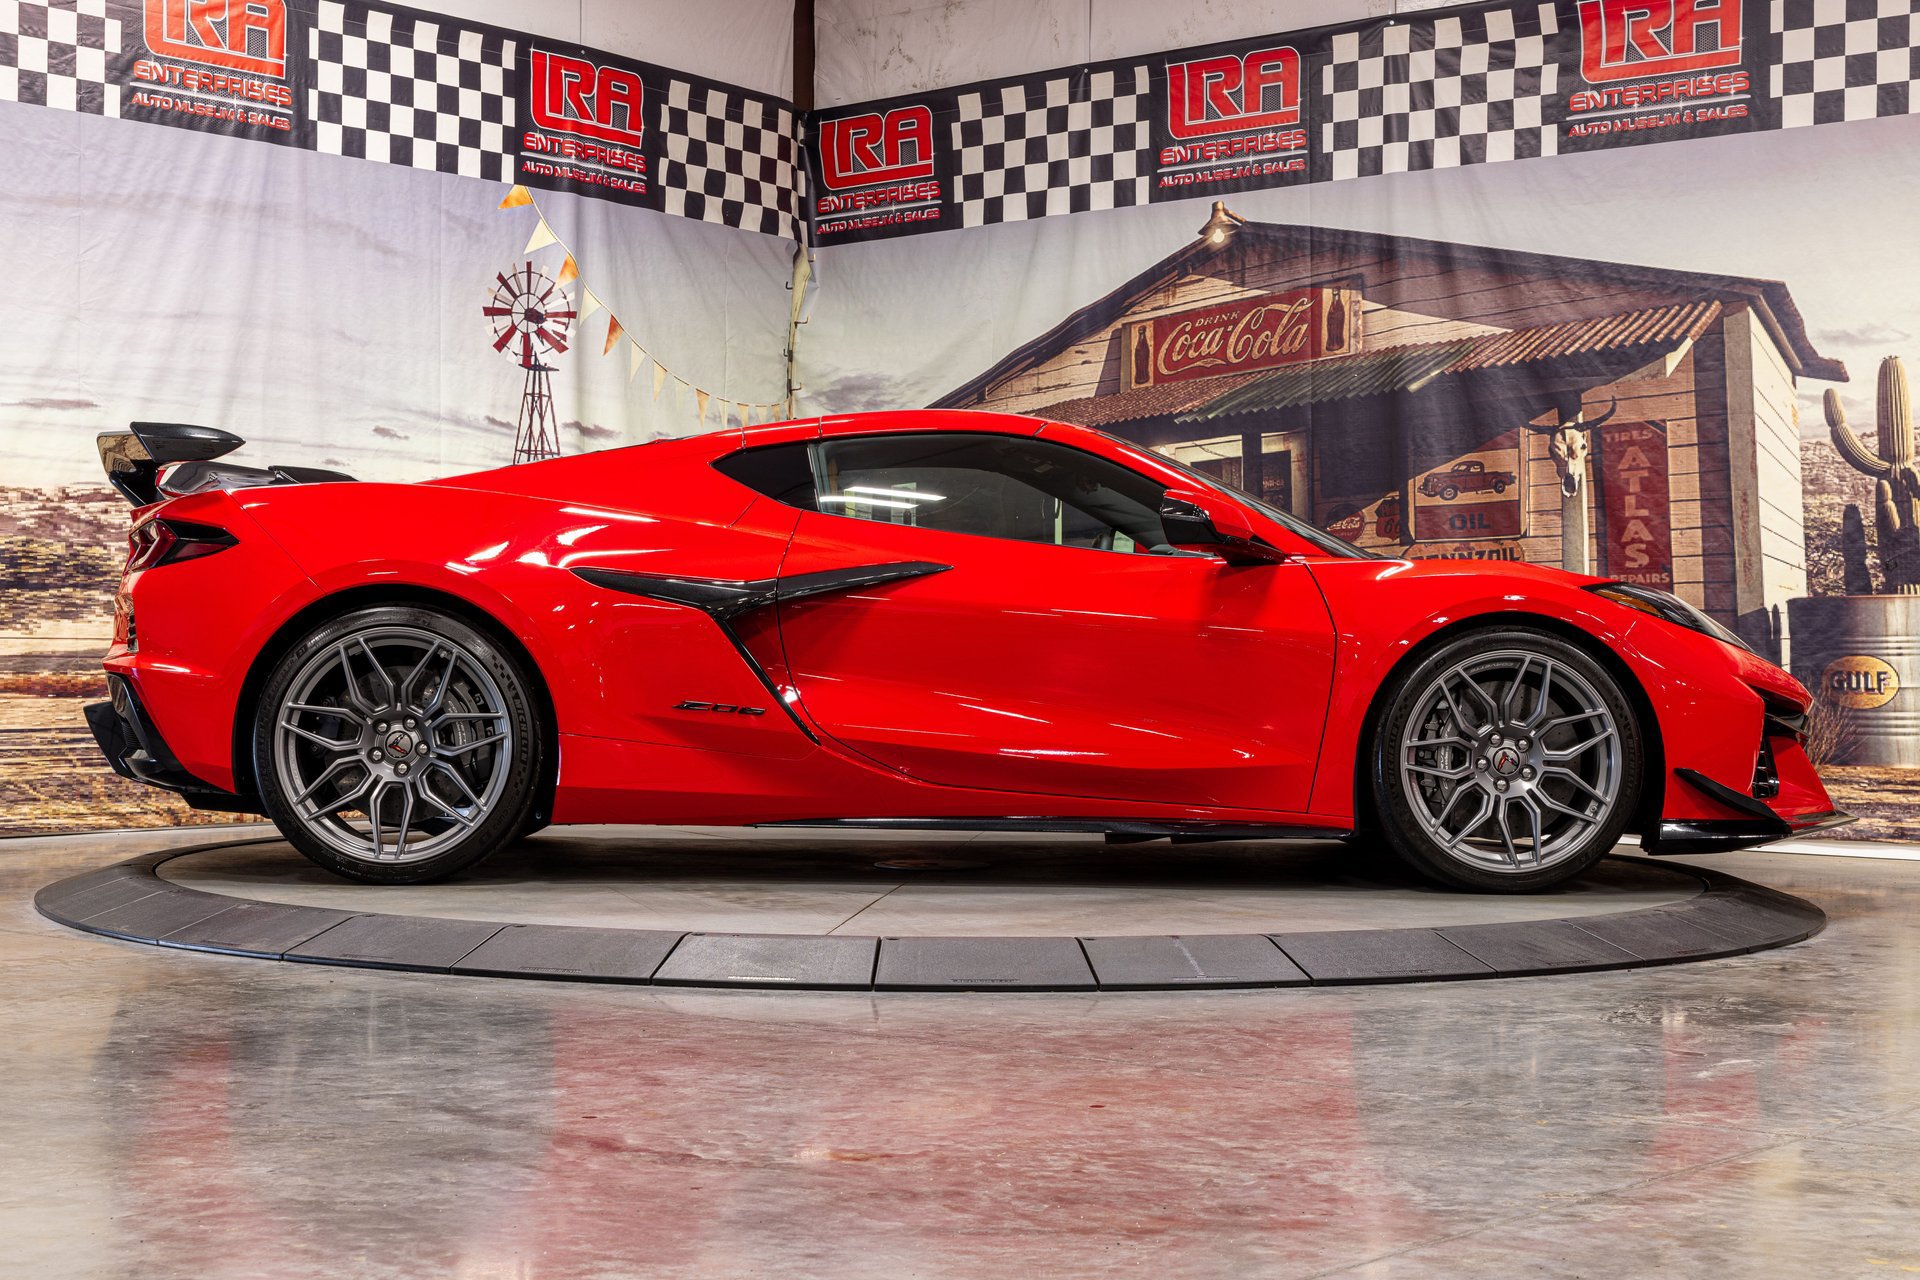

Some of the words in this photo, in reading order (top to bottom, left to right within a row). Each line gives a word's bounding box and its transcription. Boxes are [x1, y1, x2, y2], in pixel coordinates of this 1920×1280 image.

[133, 60, 293, 106] ENTERPRISES
[1569, 71, 1750, 112] ENTERPRISES
[130, 92, 172, 110] AUTO
[174, 99, 235, 121] MUSEUM
[237, 109, 248, 123] &
[248, 113, 291, 131] SALES
[1568, 119, 1612, 138] AUTO
[1613, 112, 1681, 132] MUSEUM
[1682, 110, 1694, 123] &
[1696, 104, 1749, 122] SALES
[523, 132, 647, 173] ENTERPRISES
[1159, 129, 1307, 165] ENTERPRISES
[522, 160, 553, 176] AUTO
[554, 166, 603, 184] MUSEUM
[603, 174, 610, 187] &
[611, 177, 647, 194] SALES
[1158, 171, 1194, 188] AUTO
[1194, 165, 1252, 183] MUSEUM
[1252, 163, 1262, 176] &
[1263, 159, 1306, 175] SALES
[817, 181, 940, 213] ENTERPRISES
[817, 221, 847, 234] AUTO
[848, 214, 895, 230] MUSEUM
[895, 213, 903, 223] &
[904, 208, 940, 223] SALES
[1195, 310, 1241, 327] DRINK
[1156, 297, 1316, 376] Coca-Cola
[1603, 429, 1653, 442] TIRES
[1450, 512, 1491, 530] OIL
[1617, 446, 1655, 568] ATLAS
[1829, 670, 1891, 695] GULF
[513, 696, 529, 763] MICHELIN
